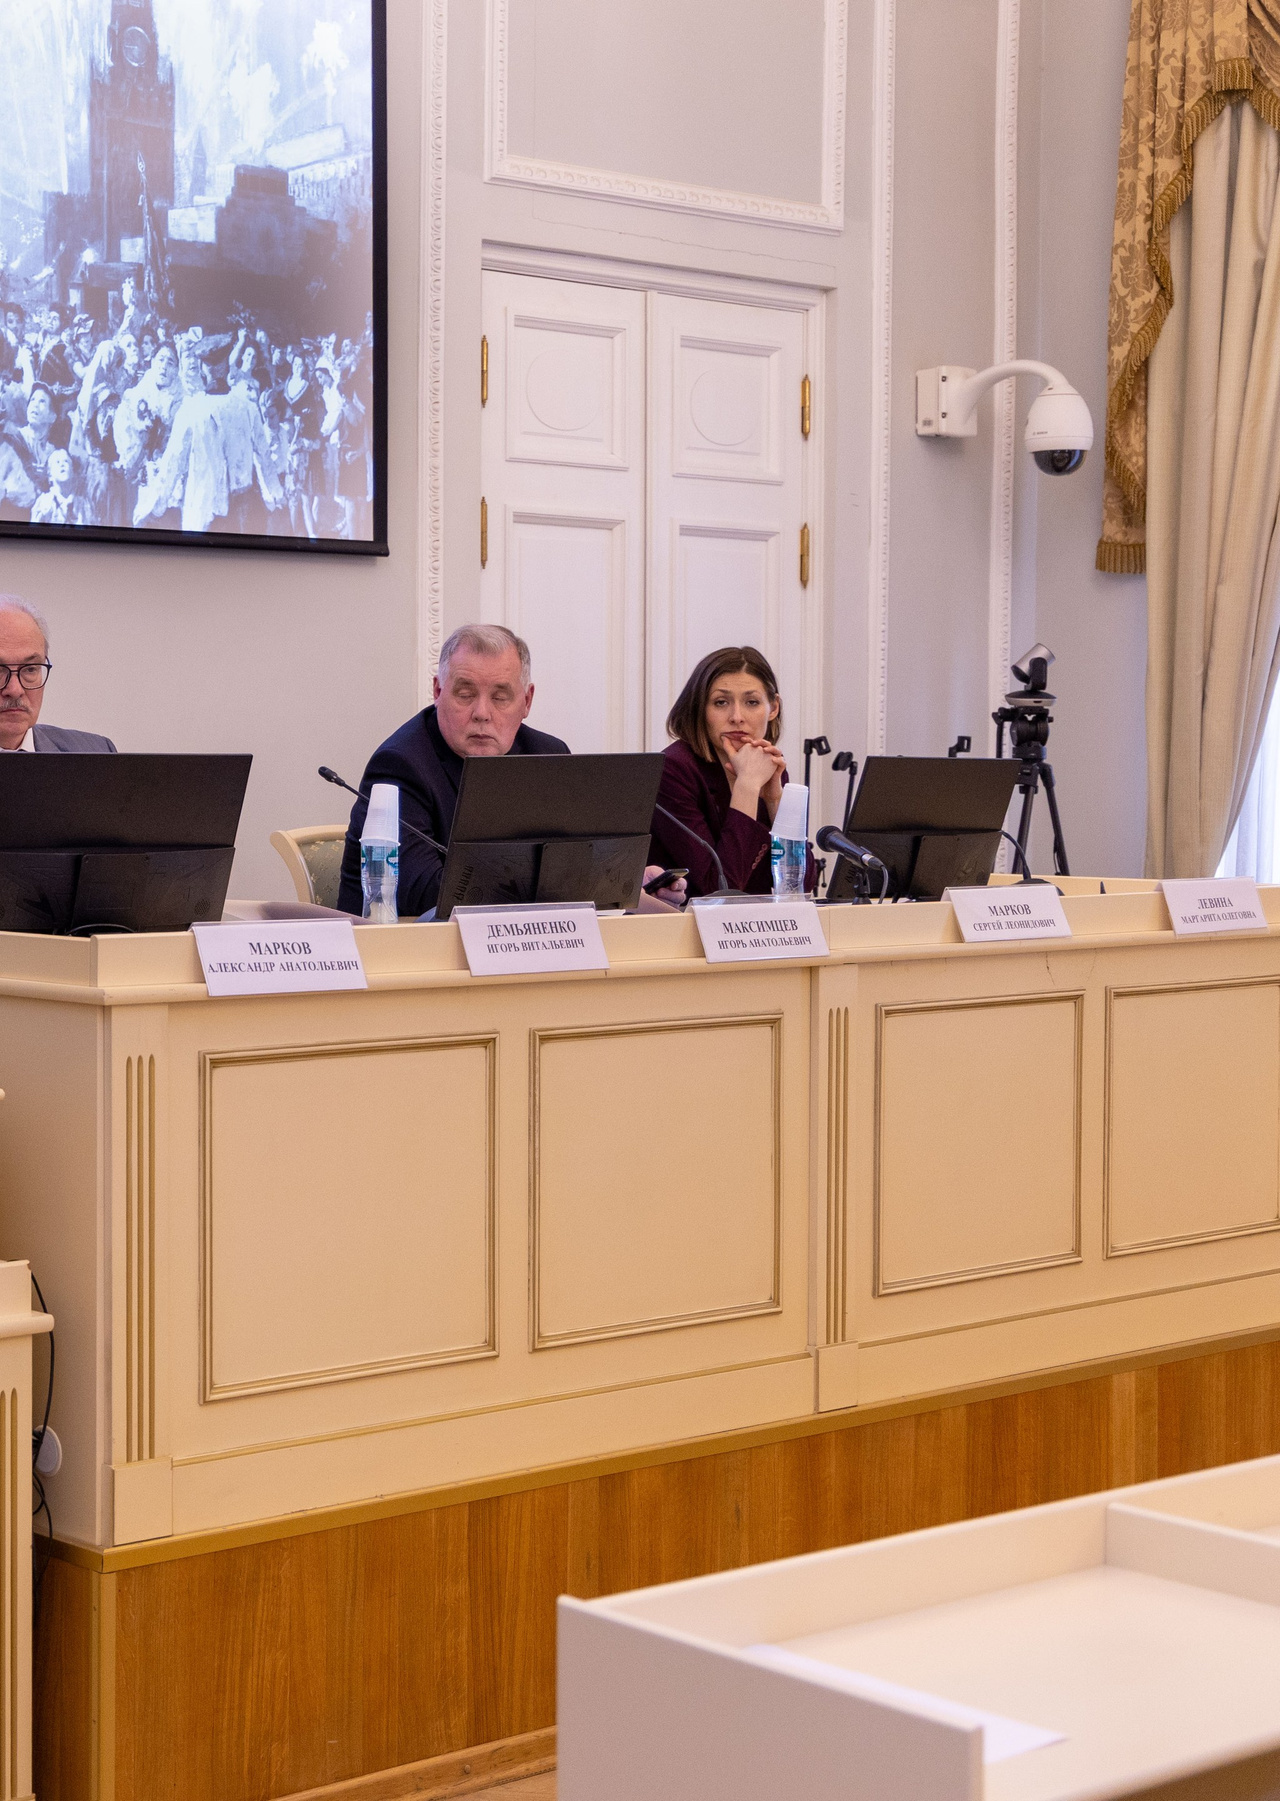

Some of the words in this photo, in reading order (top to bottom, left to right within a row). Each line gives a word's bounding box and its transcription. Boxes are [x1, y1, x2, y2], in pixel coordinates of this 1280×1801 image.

[988, 904, 1031, 916] МАРКОВ
[1198, 897, 1233, 909] ЛЕВИНА
[1181, 914, 1221, 924] МАРГАРИТА
[1222, 910, 1257, 921] ОЛЕГОВНА
[487, 920, 577, 939] ДЕМЬЯНЕНКО
[722, 919, 798, 934] МАКСИМЦЕВ
[973, 920, 1003, 931] СЕРГЕЙ
[1005, 919, 1056, 930] ЛЕОНИДОВИЧ
[248, 941, 312, 956] МАРКОВ
[487, 942, 520, 953] ИГОРЬ
[521, 938, 585, 951] ВИТАЛЬЕВИЧ
[718, 939, 747, 950] ИГОРЬ
[749, 936, 812, 948] АНАТОЛЬЕВИЧ
[208, 962, 275, 973] АЛЕКСАНДР
[279, 960, 360, 972] АНАТОЛЬЕВИЧ
